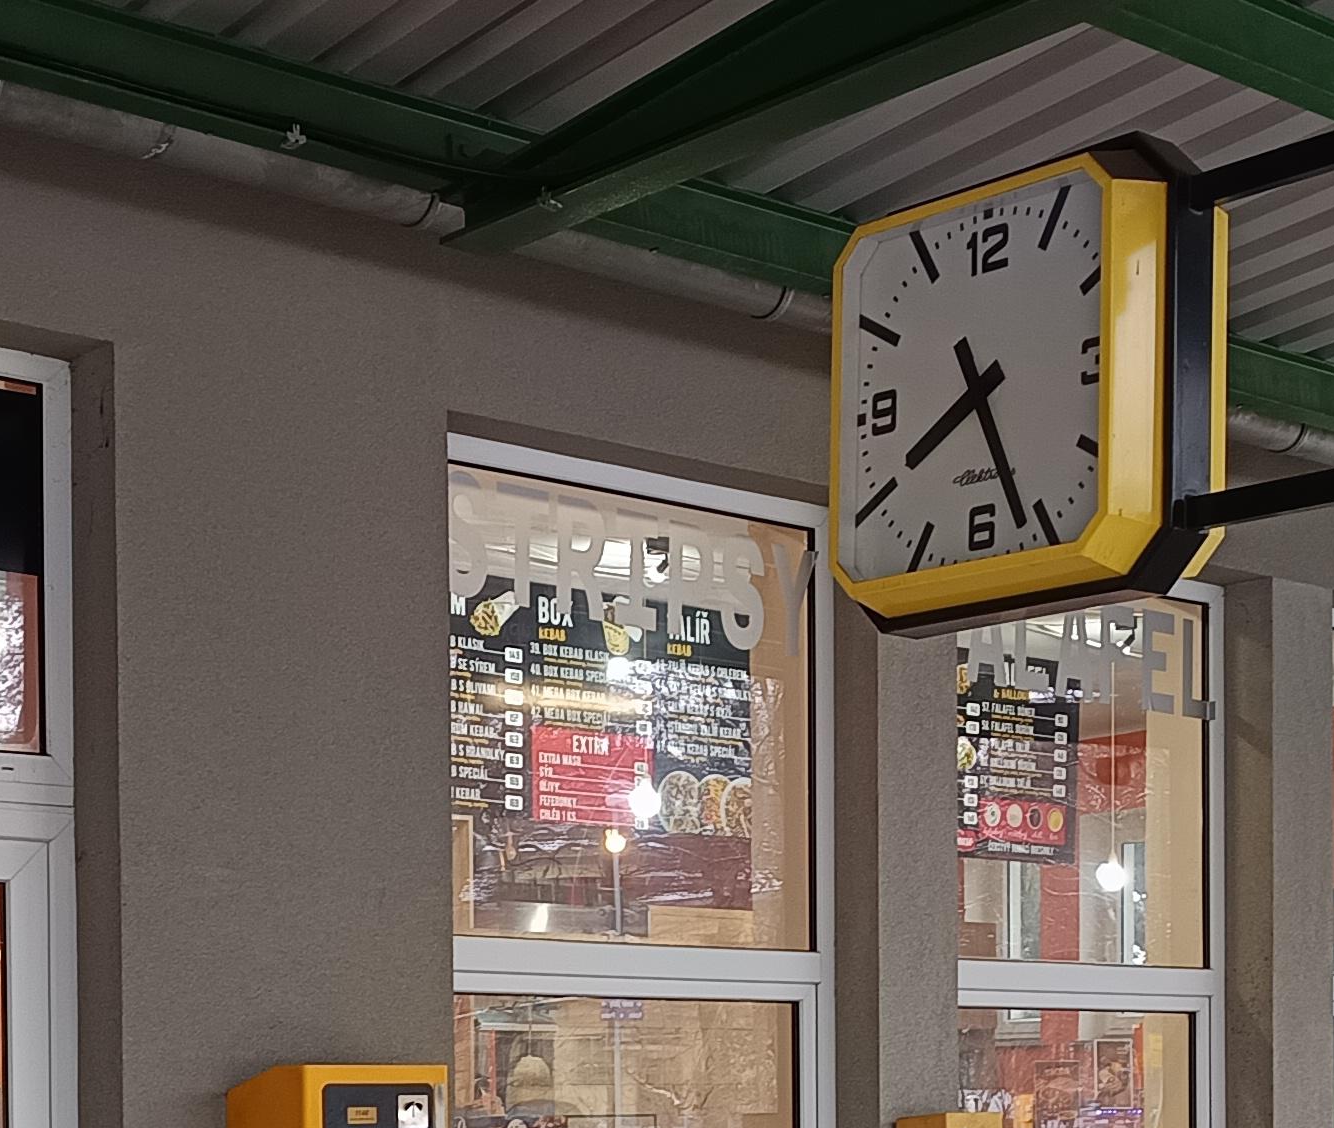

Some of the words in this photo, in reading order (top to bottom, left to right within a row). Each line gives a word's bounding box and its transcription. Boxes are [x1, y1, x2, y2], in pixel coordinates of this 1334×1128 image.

[967, 222, 1009, 277] 12
[871, 388, 897, 437] 9
[968, 503, 996, 551] 6
[538, 627, 566, 642] KEBAB
[966, 606, 1216, 720] ALAFEL
